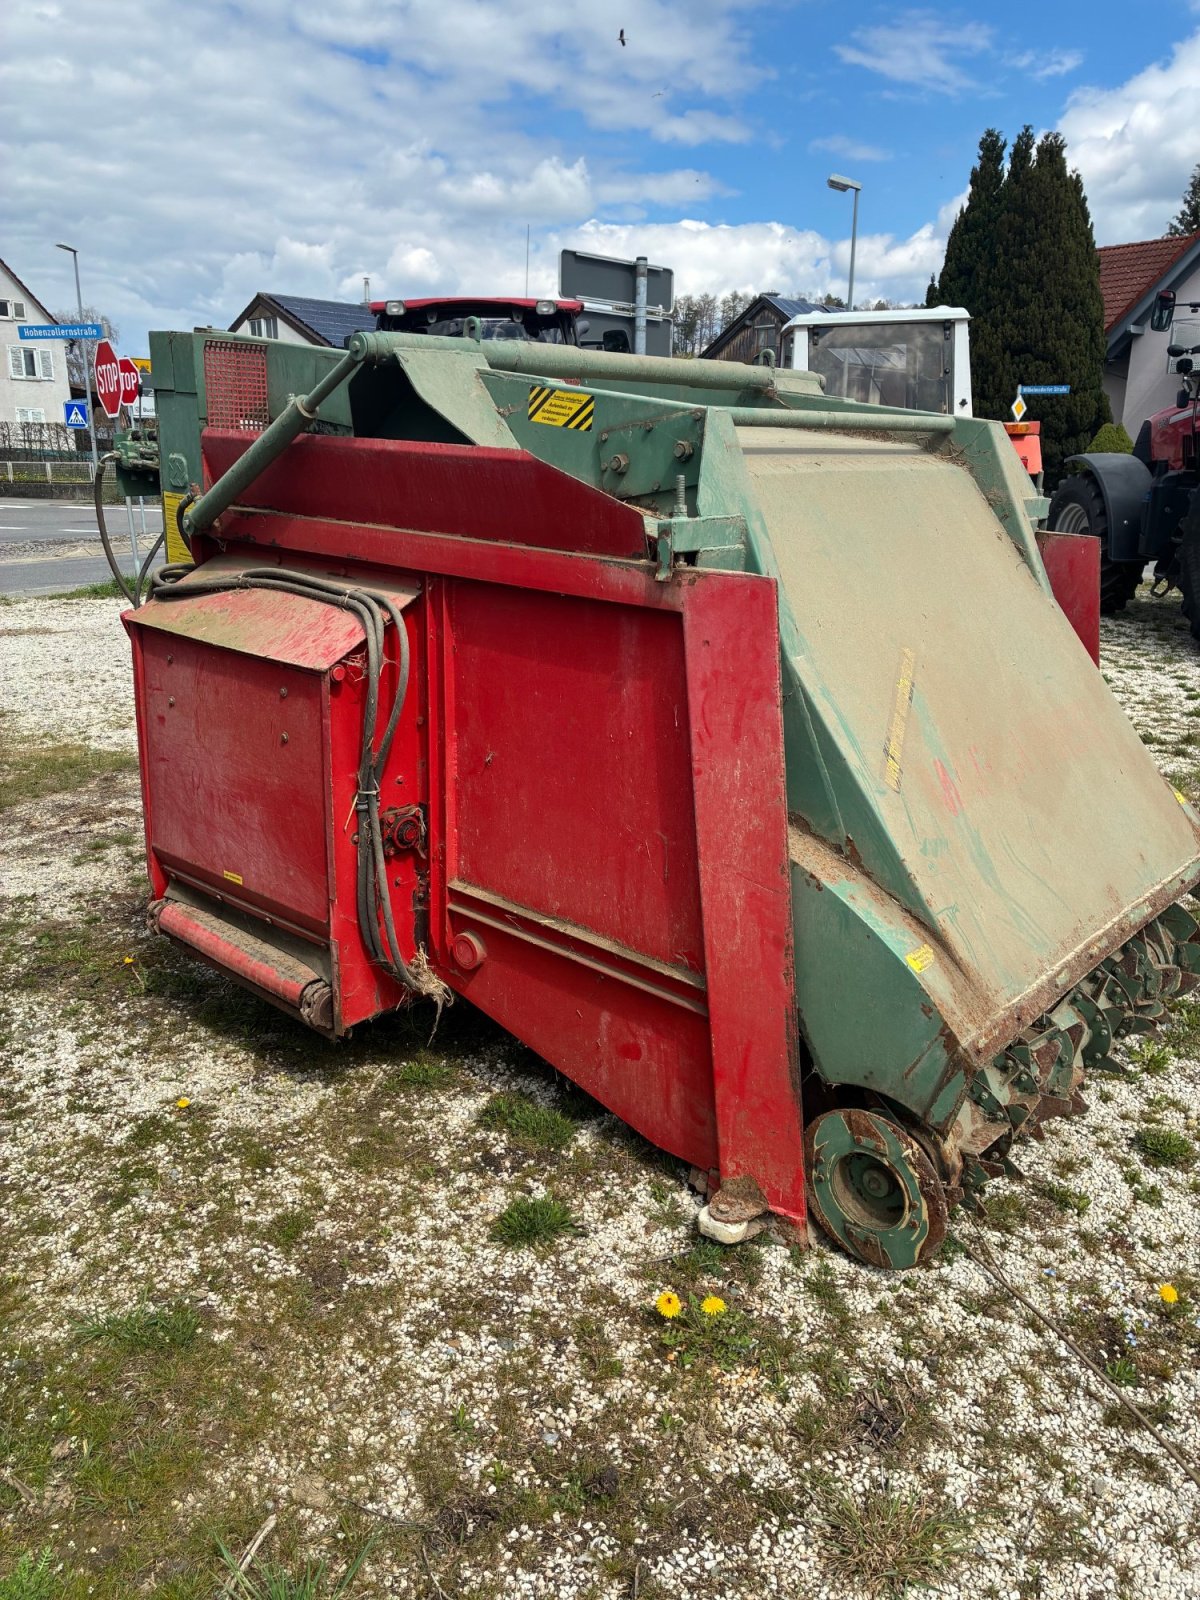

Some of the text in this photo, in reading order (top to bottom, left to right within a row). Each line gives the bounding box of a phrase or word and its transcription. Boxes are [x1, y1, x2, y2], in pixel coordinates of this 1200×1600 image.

[23, 327, 97, 336] Hohenzollernstraße
[97, 362, 118, 394] STOP
[120, 372, 137, 391] TOP
